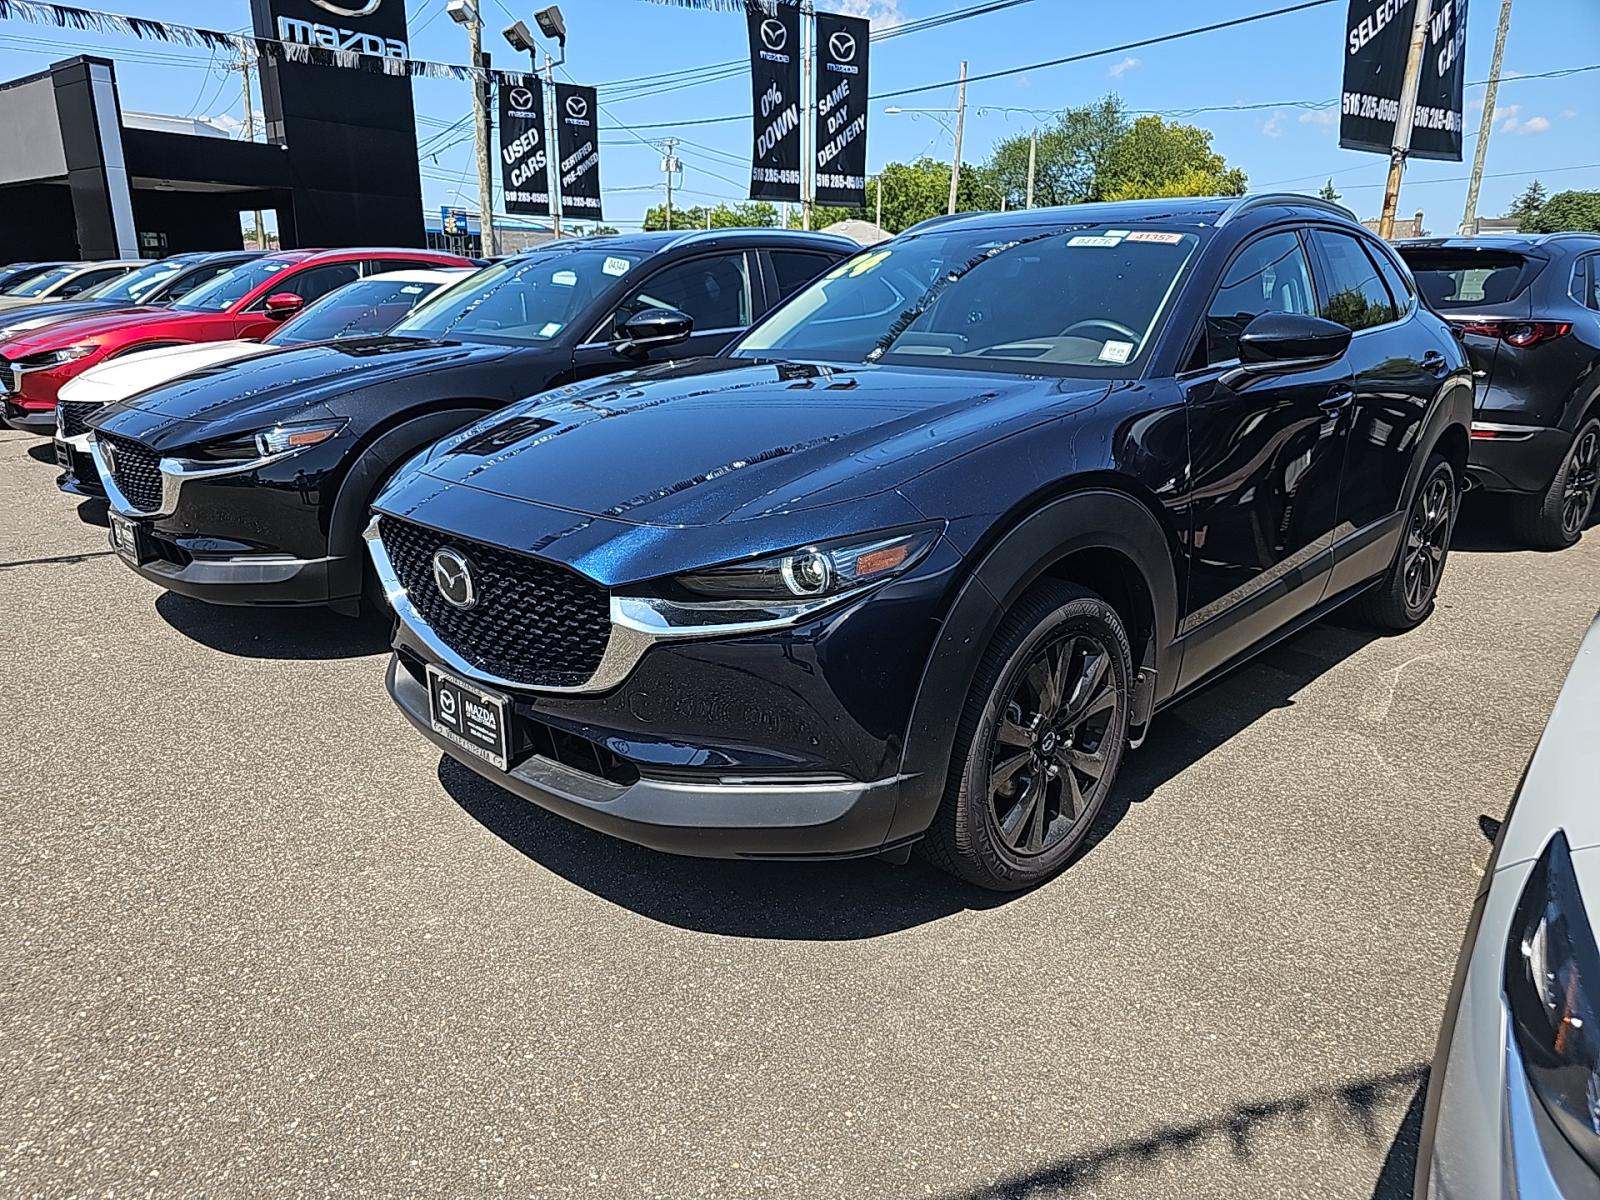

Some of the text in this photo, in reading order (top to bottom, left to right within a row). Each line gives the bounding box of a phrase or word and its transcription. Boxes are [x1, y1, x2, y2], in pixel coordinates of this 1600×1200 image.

[277, 16, 408, 59] mazda
[1431, 1, 1452, 45] WE
[760, 50, 789, 63] mazda
[826, 63, 858, 74] mazda
[761, 82, 782, 117] 0%
[819, 79, 850, 116] SAME
[1343, 92, 1399, 122] 516 285-0505
[757, 103, 798, 159] DOWN
[827, 105, 848, 134] DAY
[1414, 105, 1429, 128] 516
[502, 128, 539, 164] USED
[561, 141, 593, 172] CERTIFIED
[817, 114, 865, 167] DELIVERY
[511, 150, 547, 187] CARS
[562, 152, 599, 188] PRE-OWNED
[764, 168, 799, 184] 285-0505
[816, 173, 864, 189] 516 285-0505
[465, 701, 496, 726] MAZDA
